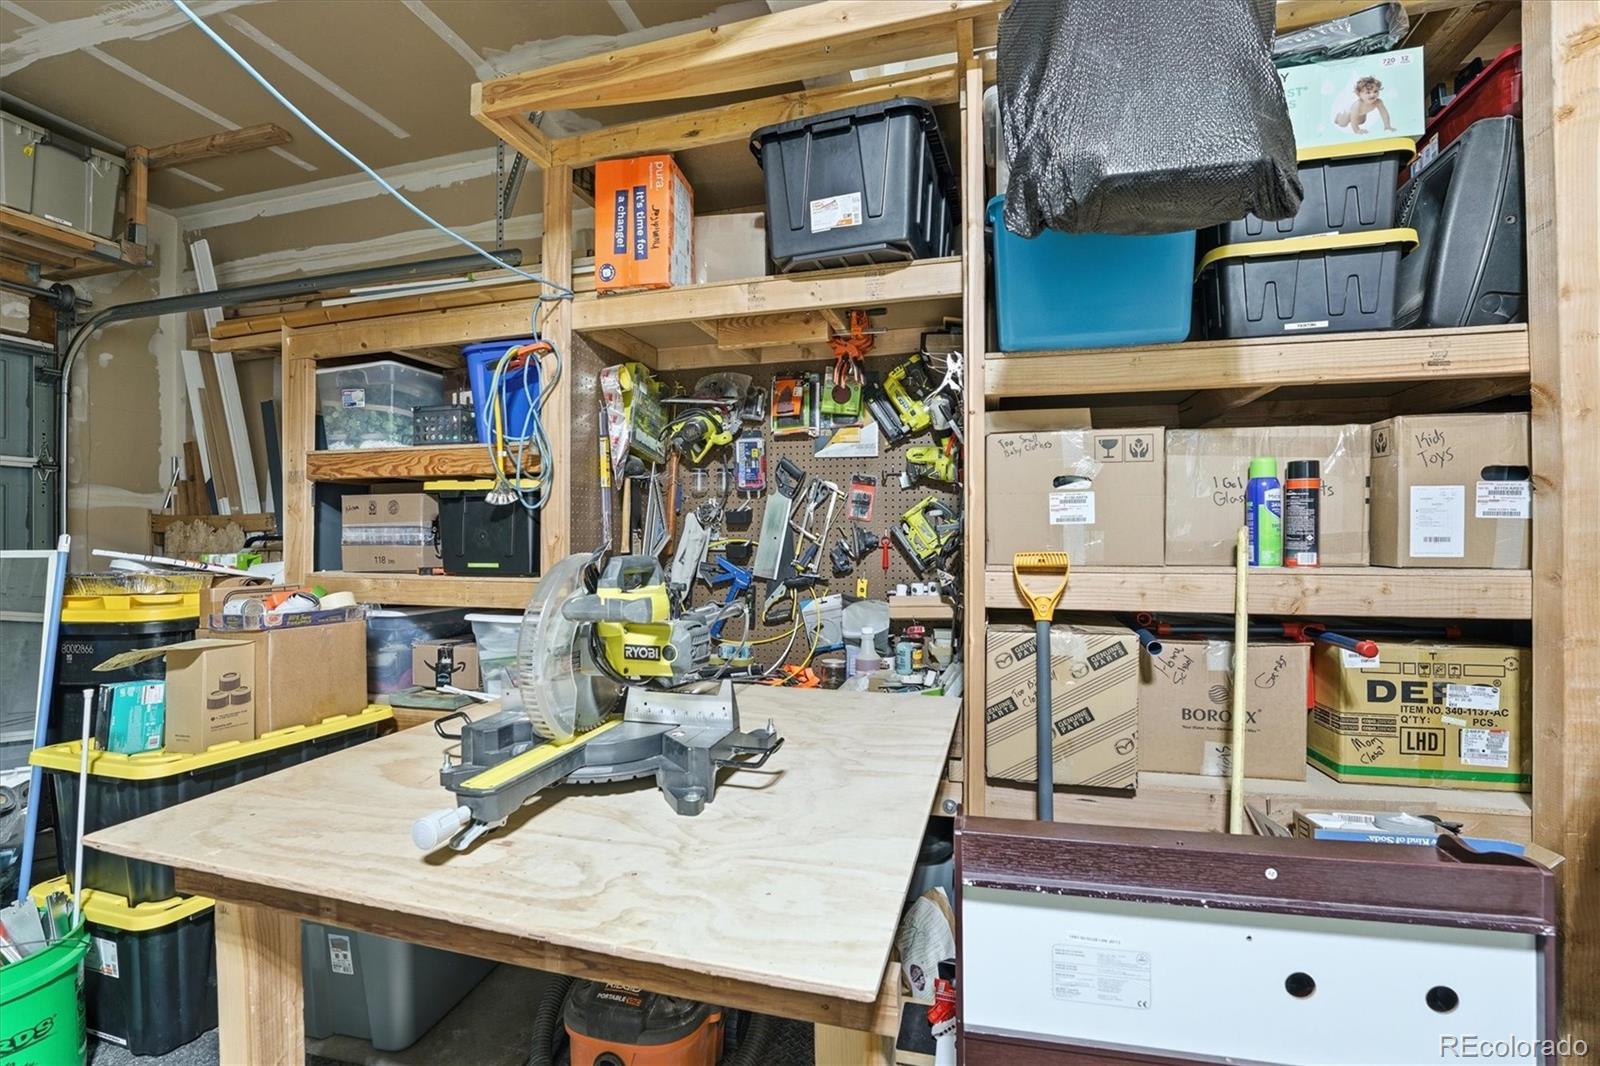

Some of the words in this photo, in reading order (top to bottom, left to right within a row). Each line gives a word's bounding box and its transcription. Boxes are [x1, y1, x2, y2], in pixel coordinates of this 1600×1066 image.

[1280, 72, 1289, 83] Y
[635, 190, 645, 209] It's
[615, 206, 626, 248] change!
[635, 210, 645, 236] time
[636, 239, 645, 255] for
[1415, 428, 1446, 449] Kids
[1417, 446, 1454, 469] Toys
[624, 646, 660, 659] RYOBI
[1090, 644, 1122, 663] GENUINE
[1094, 649, 1128, 668] PARTS
[1057, 709, 1089, 728] GENUINE
[1182, 708, 1257, 724] BOROX
[1400, 705, 1424, 714] ITEM
[1426, 706, 1444, 715] NO.
[1060, 714, 1091, 733] PARTS
[1400, 715, 1431, 724] Q'TY:
[1472, 718, 1498, 728] PCS.
[1350, 737, 1384, 752] Mom
[1407, 731, 1438, 751] LHD
[1368, 835, 1395, 844] Soda
[1395, 836, 1406, 845] of
[1407, 837, 1430, 846] Kind
